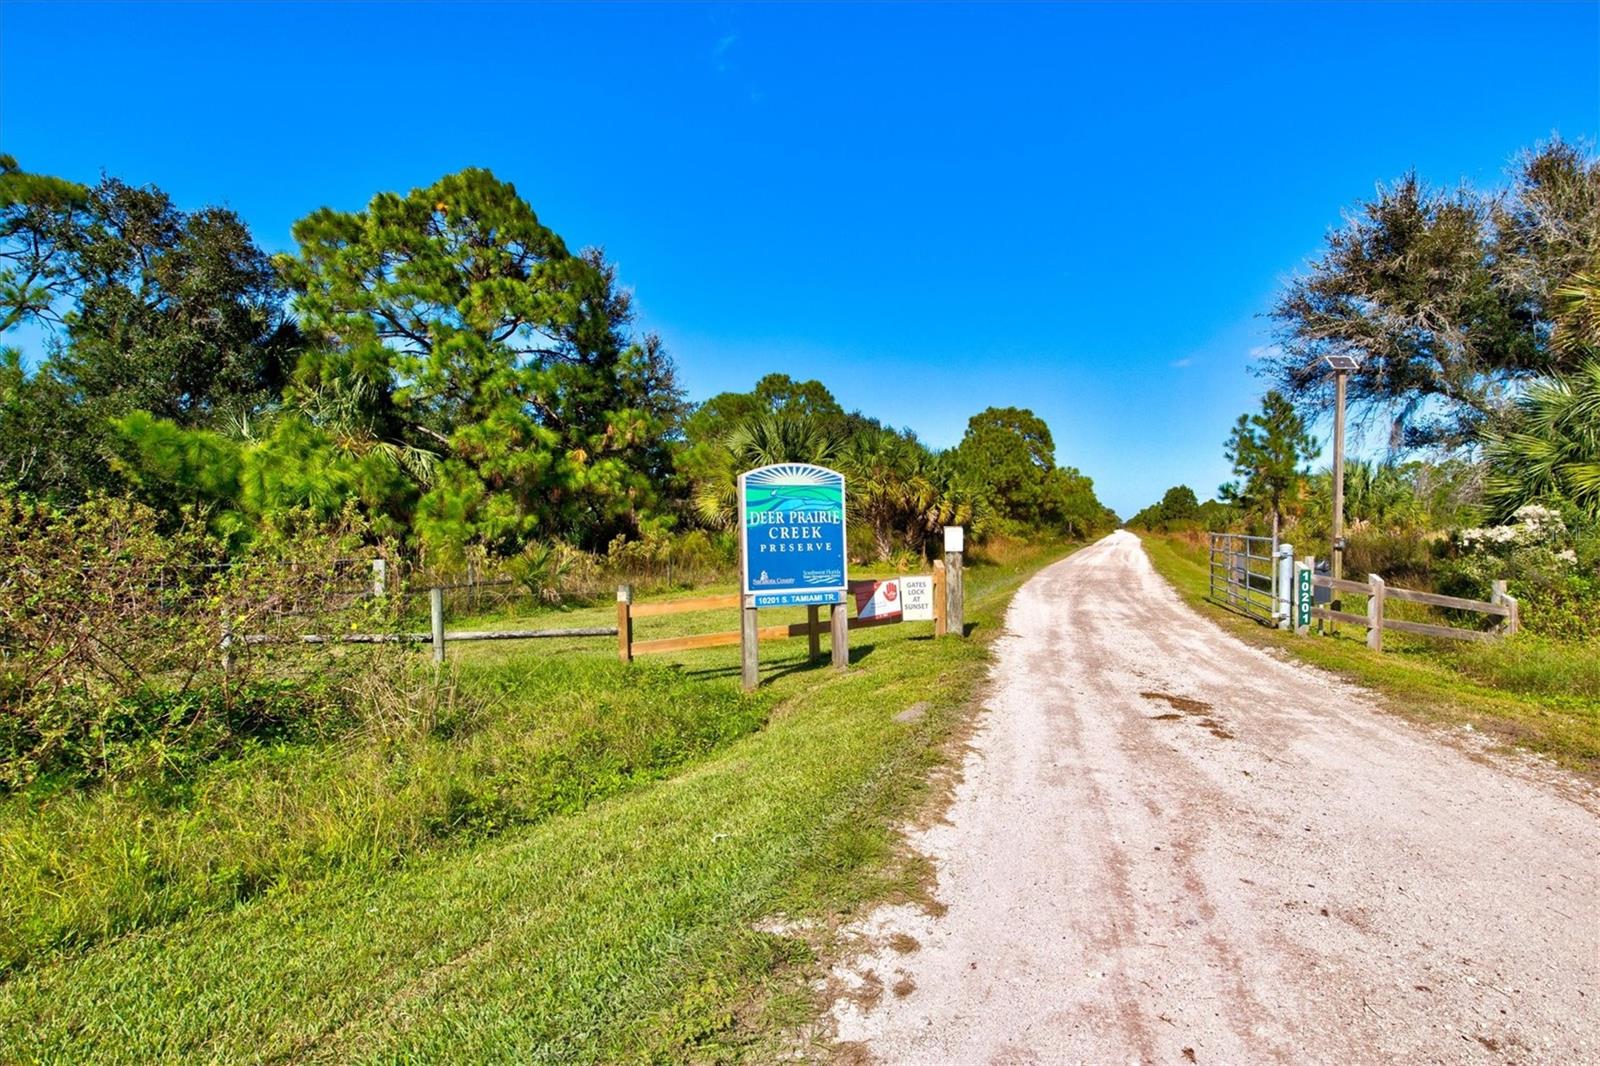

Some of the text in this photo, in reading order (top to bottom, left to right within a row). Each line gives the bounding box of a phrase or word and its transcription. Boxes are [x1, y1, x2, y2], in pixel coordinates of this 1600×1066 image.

[750, 510, 840, 525] DEER PRAIRIE
[768, 526, 822, 539] CREEK
[760, 543, 832, 553] PRESERVE
[907, 588, 925, 596] LOCK
[1301, 571, 1309, 623] 10201
[758, 593, 836, 605] 10201 S. TAMIAMI TR.
